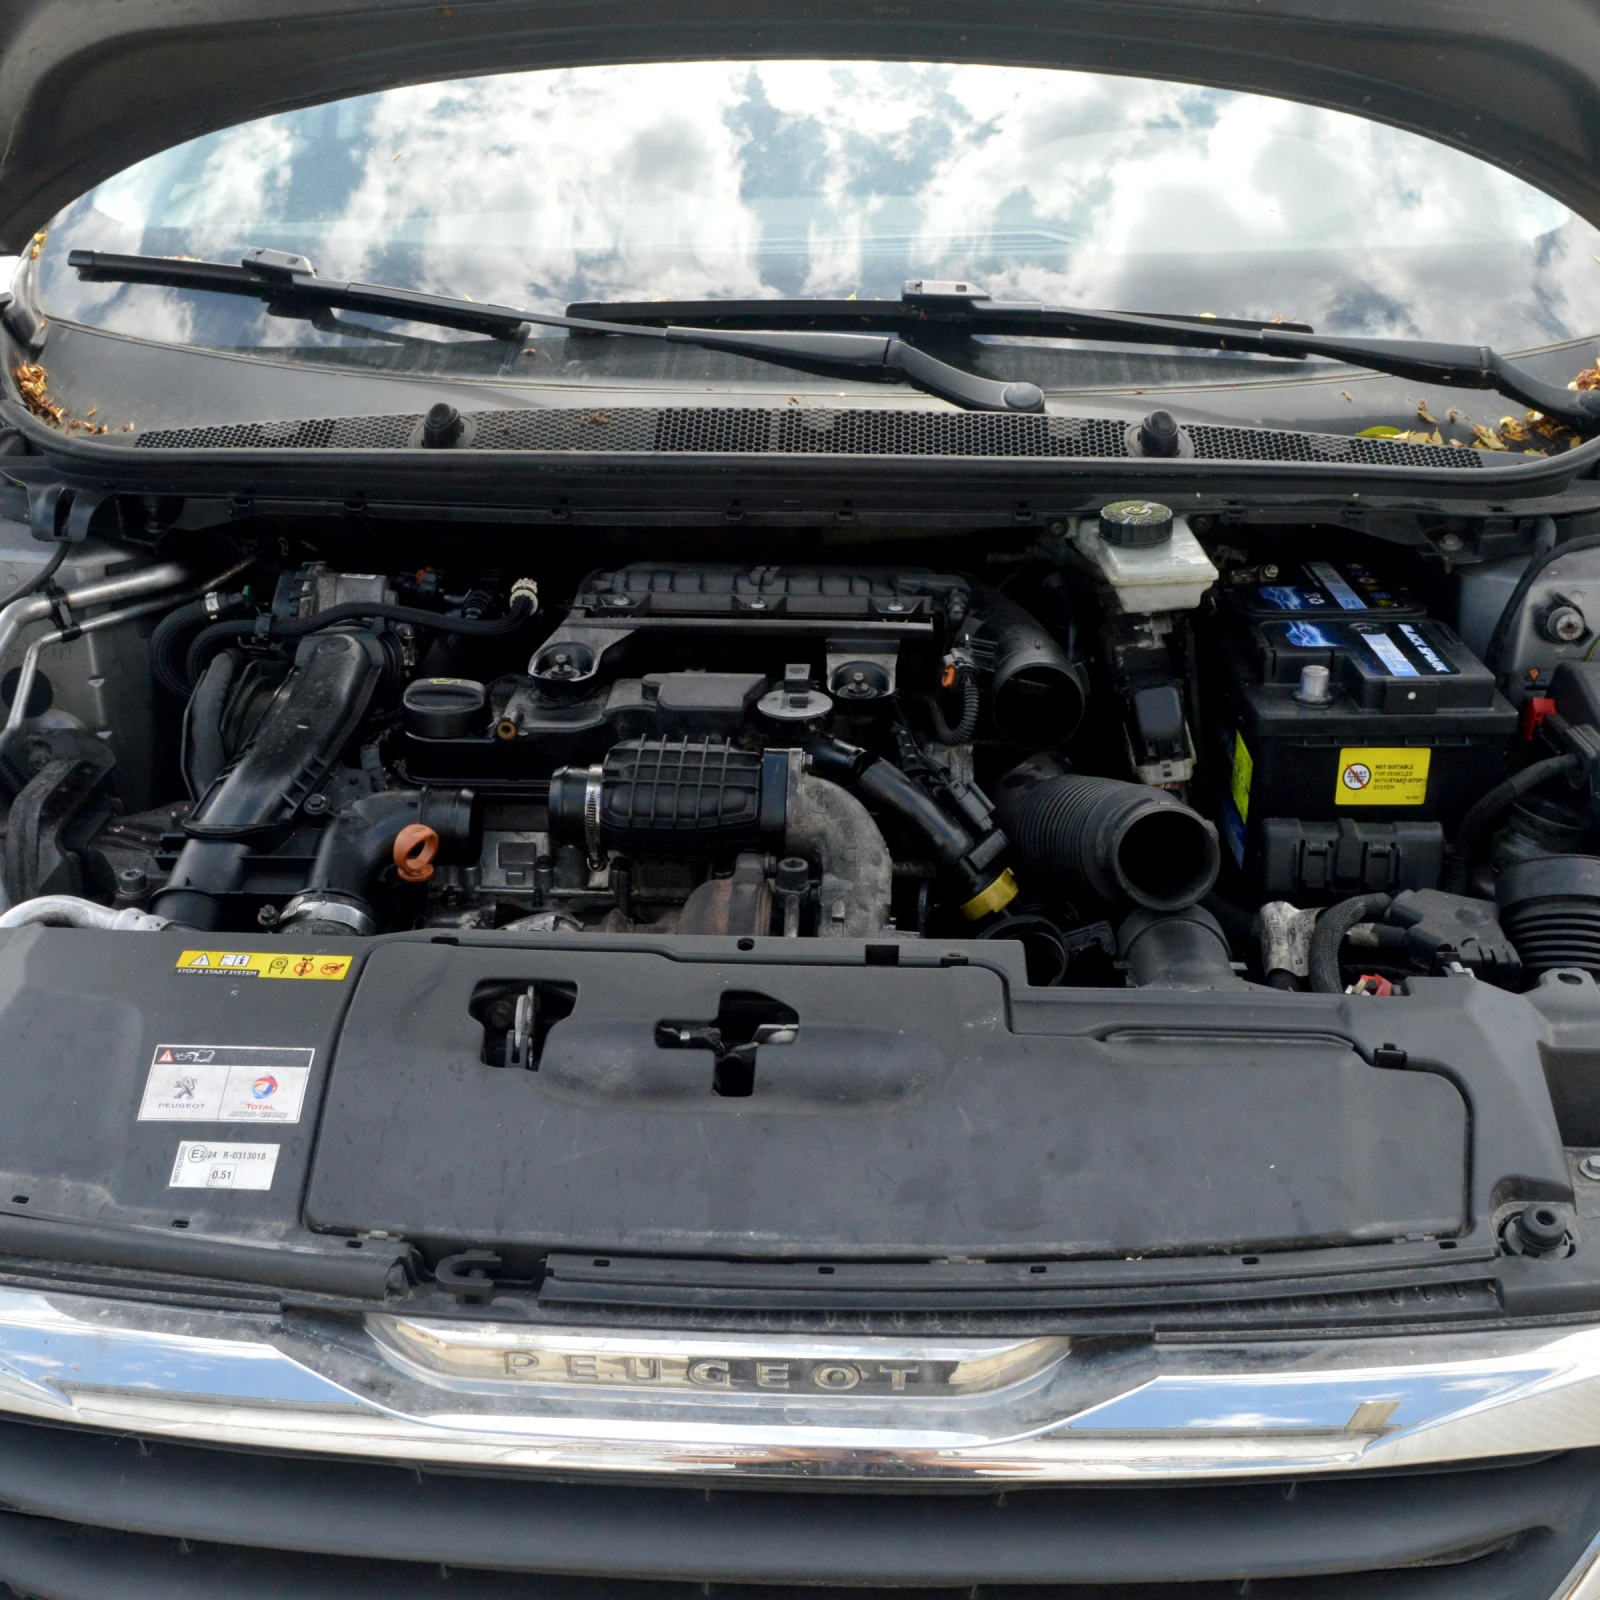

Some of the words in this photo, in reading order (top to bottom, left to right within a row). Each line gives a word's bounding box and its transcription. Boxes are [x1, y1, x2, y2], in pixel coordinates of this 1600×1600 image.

[1398, 624, 1428, 647] BLACK
[1417, 646, 1451, 673] SPARK
[223, 1151, 267, 1160] R-0313018
[211, 1170, 232, 1179] 0.51
[503, 1351, 920, 1391] PEUGEOT
